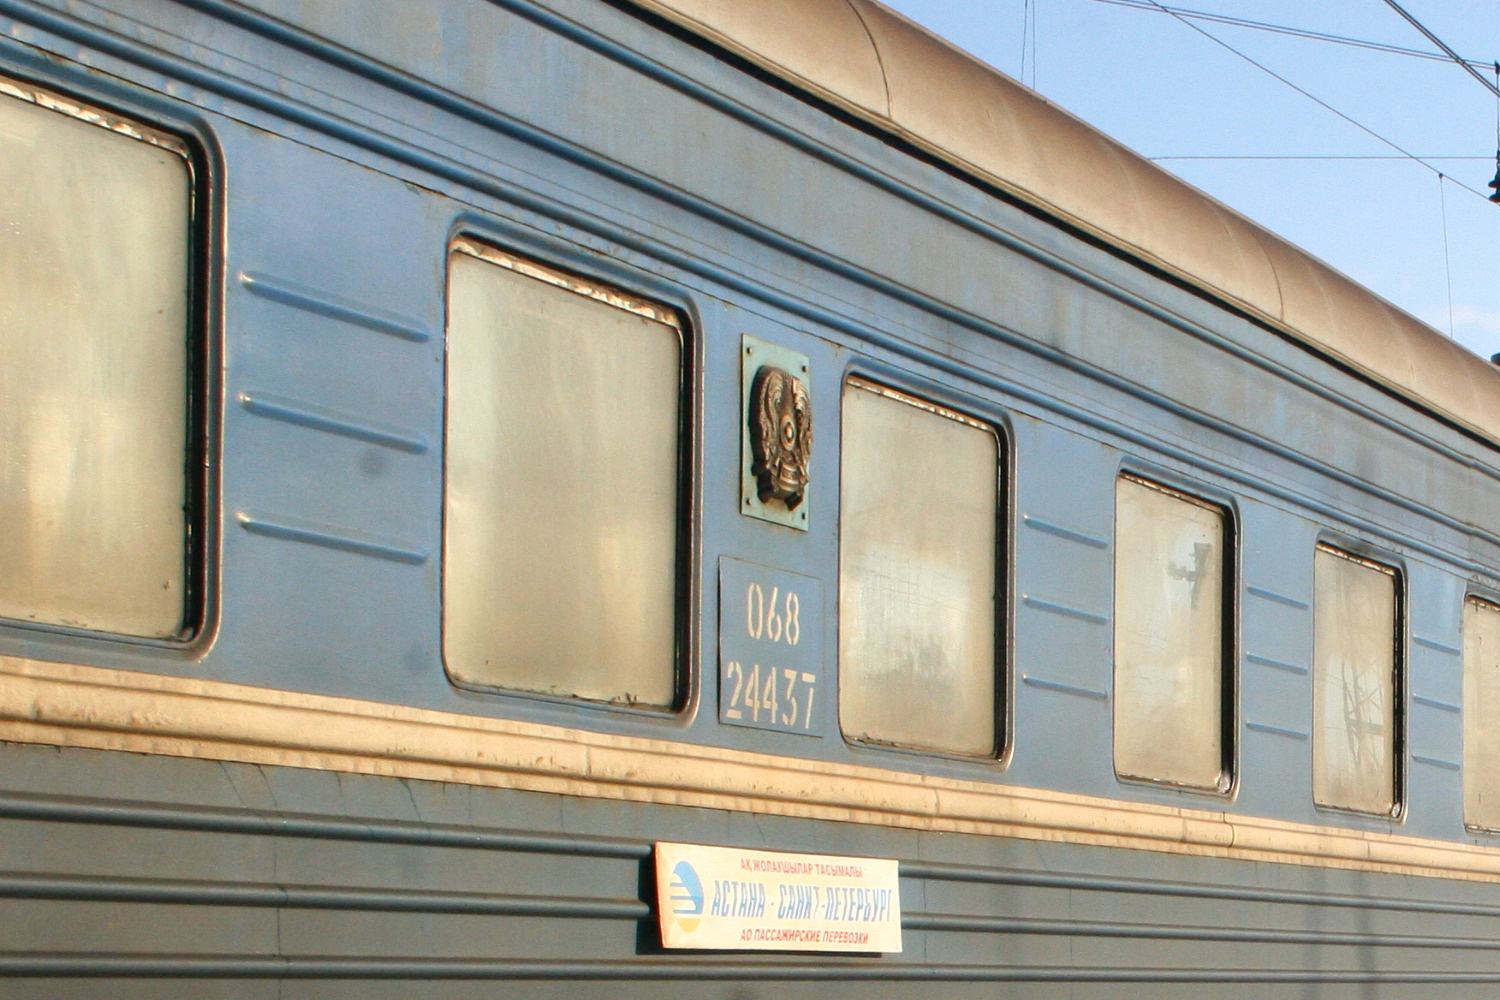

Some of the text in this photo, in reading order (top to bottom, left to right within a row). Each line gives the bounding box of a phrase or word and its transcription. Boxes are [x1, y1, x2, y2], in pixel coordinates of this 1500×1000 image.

[746, 583, 800, 646] 068
[725, 661, 816, 729] 24437
[752, 859, 813, 875] ЖОЛАУШЫЛАР
[815, 863, 863, 878] ТАСЫМАЛЫ
[711, 880, 765, 918] АСТАНА
[740, 928, 869, 945] АО ПАССАЖИРСКИЕ ПЕРЕВОЗКИ
